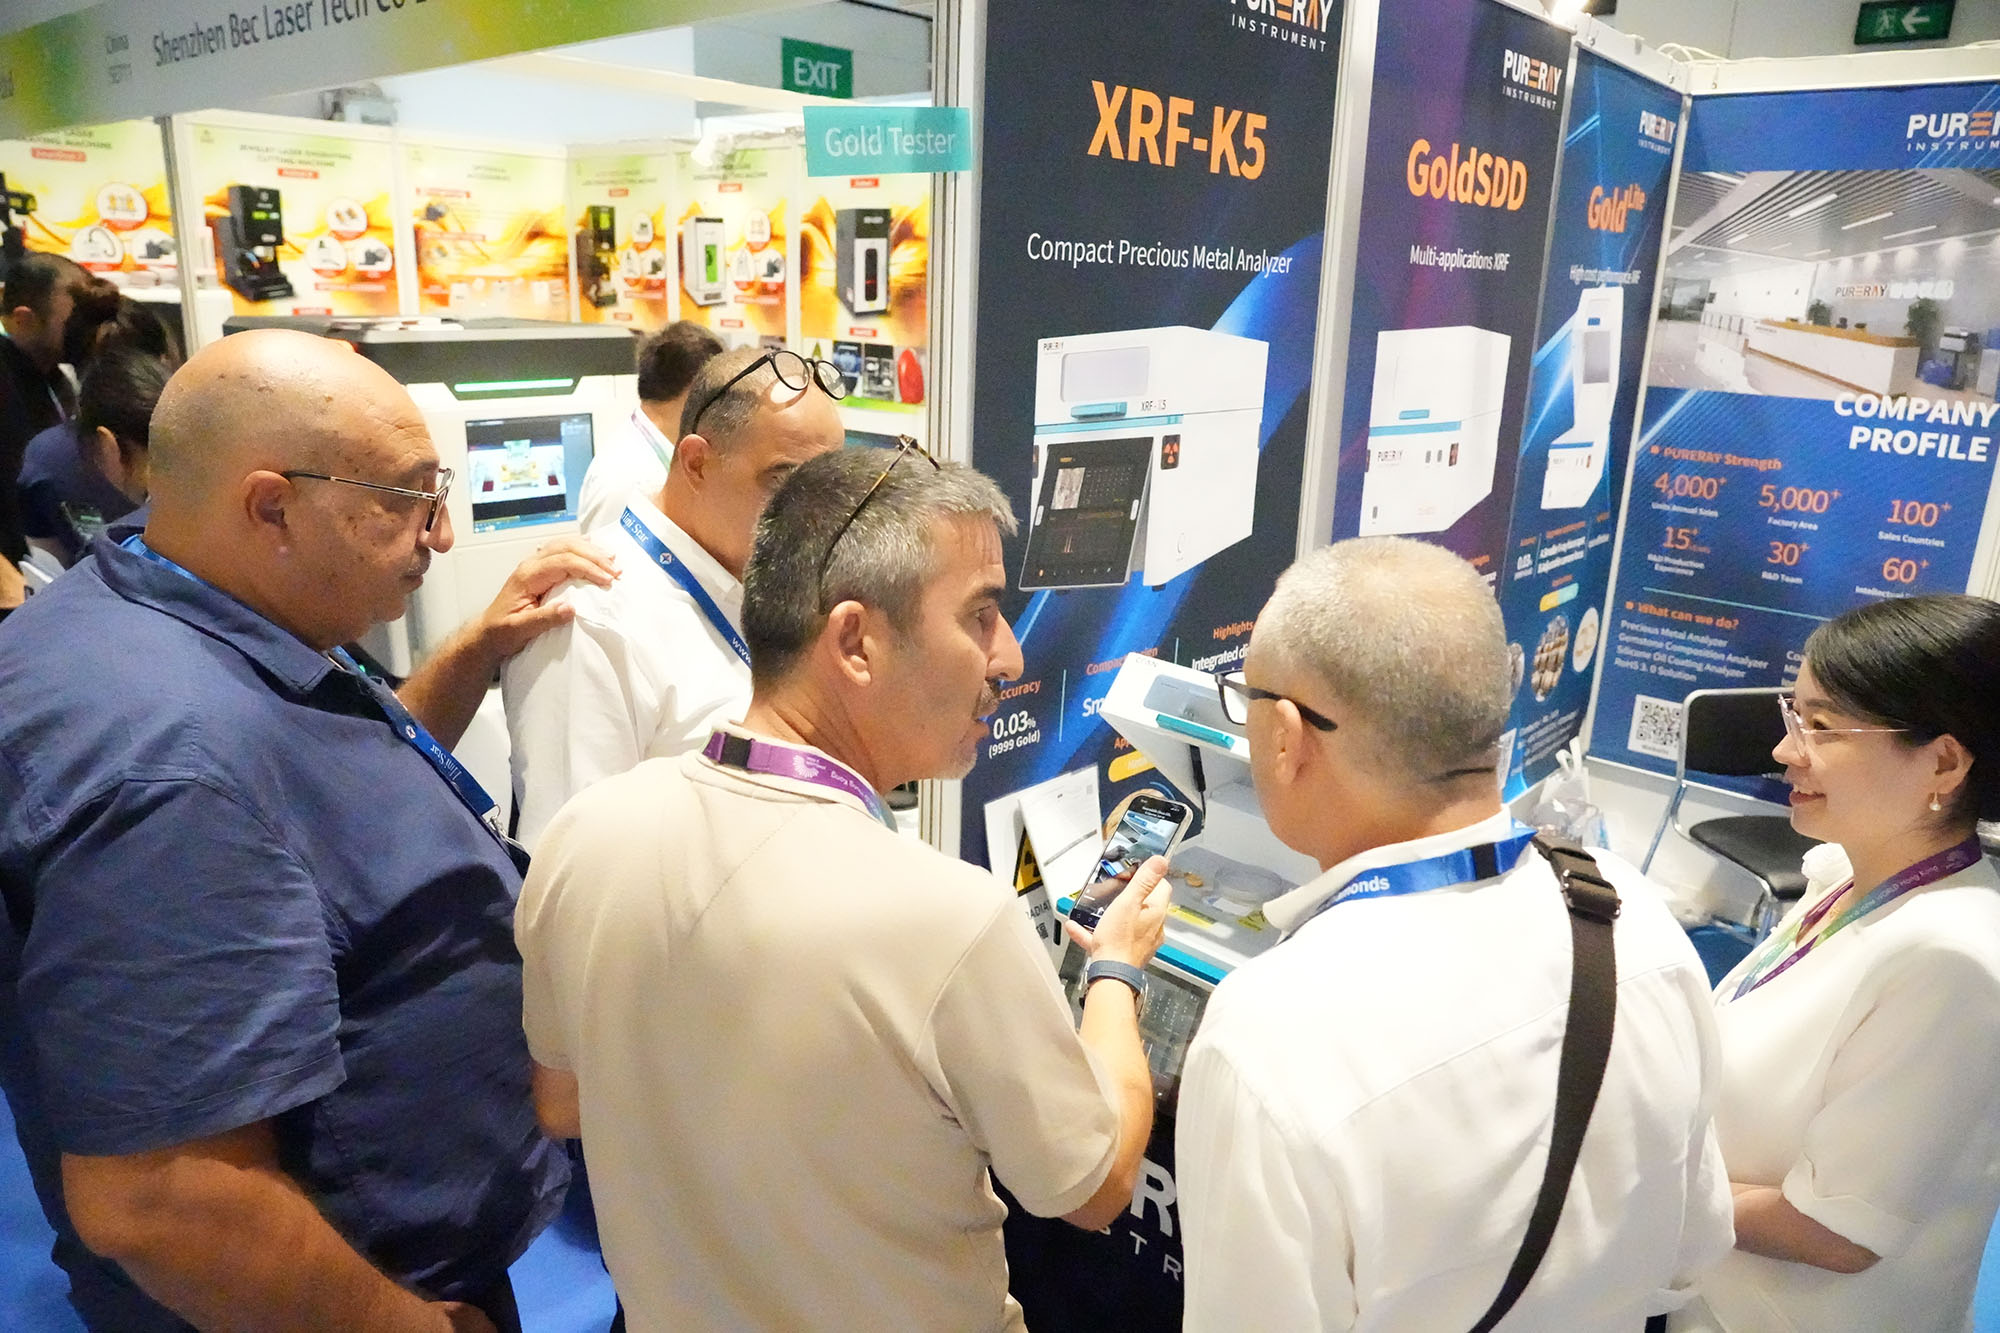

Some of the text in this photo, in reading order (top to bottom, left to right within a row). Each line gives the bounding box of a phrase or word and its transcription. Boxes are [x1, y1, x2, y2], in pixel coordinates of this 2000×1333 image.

[1230, 0, 1334, 33] ERAY
[1231, 13, 1327, 52] INSTRUMENT
[153, 22, 227, 66] Shenzhen
[228, 13, 260, 49] Bec
[264, 1, 313, 40] Laser
[793, 57, 842, 91] EXIT
[1502, 49, 1563, 96] PURERAY
[1502, 86, 1557, 110] INSTRUMENT
[825, 126, 955, 157] Gold Tester
[1087, 80, 1268, 180] XRF-K5
[1407, 139, 1528, 211] GoldSDD
[1027, 232, 1293, 278] Compact Precious Metal Analyzer
[1409, 244, 1494, 273] Multi-applications
[1833, 391, 2000, 428] COMPANY
[1848, 425, 1991, 462] PROFILE
[1724, 453, 1782, 472] Strength
[1878, 530, 1945, 548] Sales Countries
[1213, 620, 1254, 640] Highlights
[1638, 602, 1740, 631] What can we do?
[1192, 645, 1238, 671] Integrated
[1000, 680, 1042, 700] ccuracy
[1016, 729, 1041, 748] Gold)
